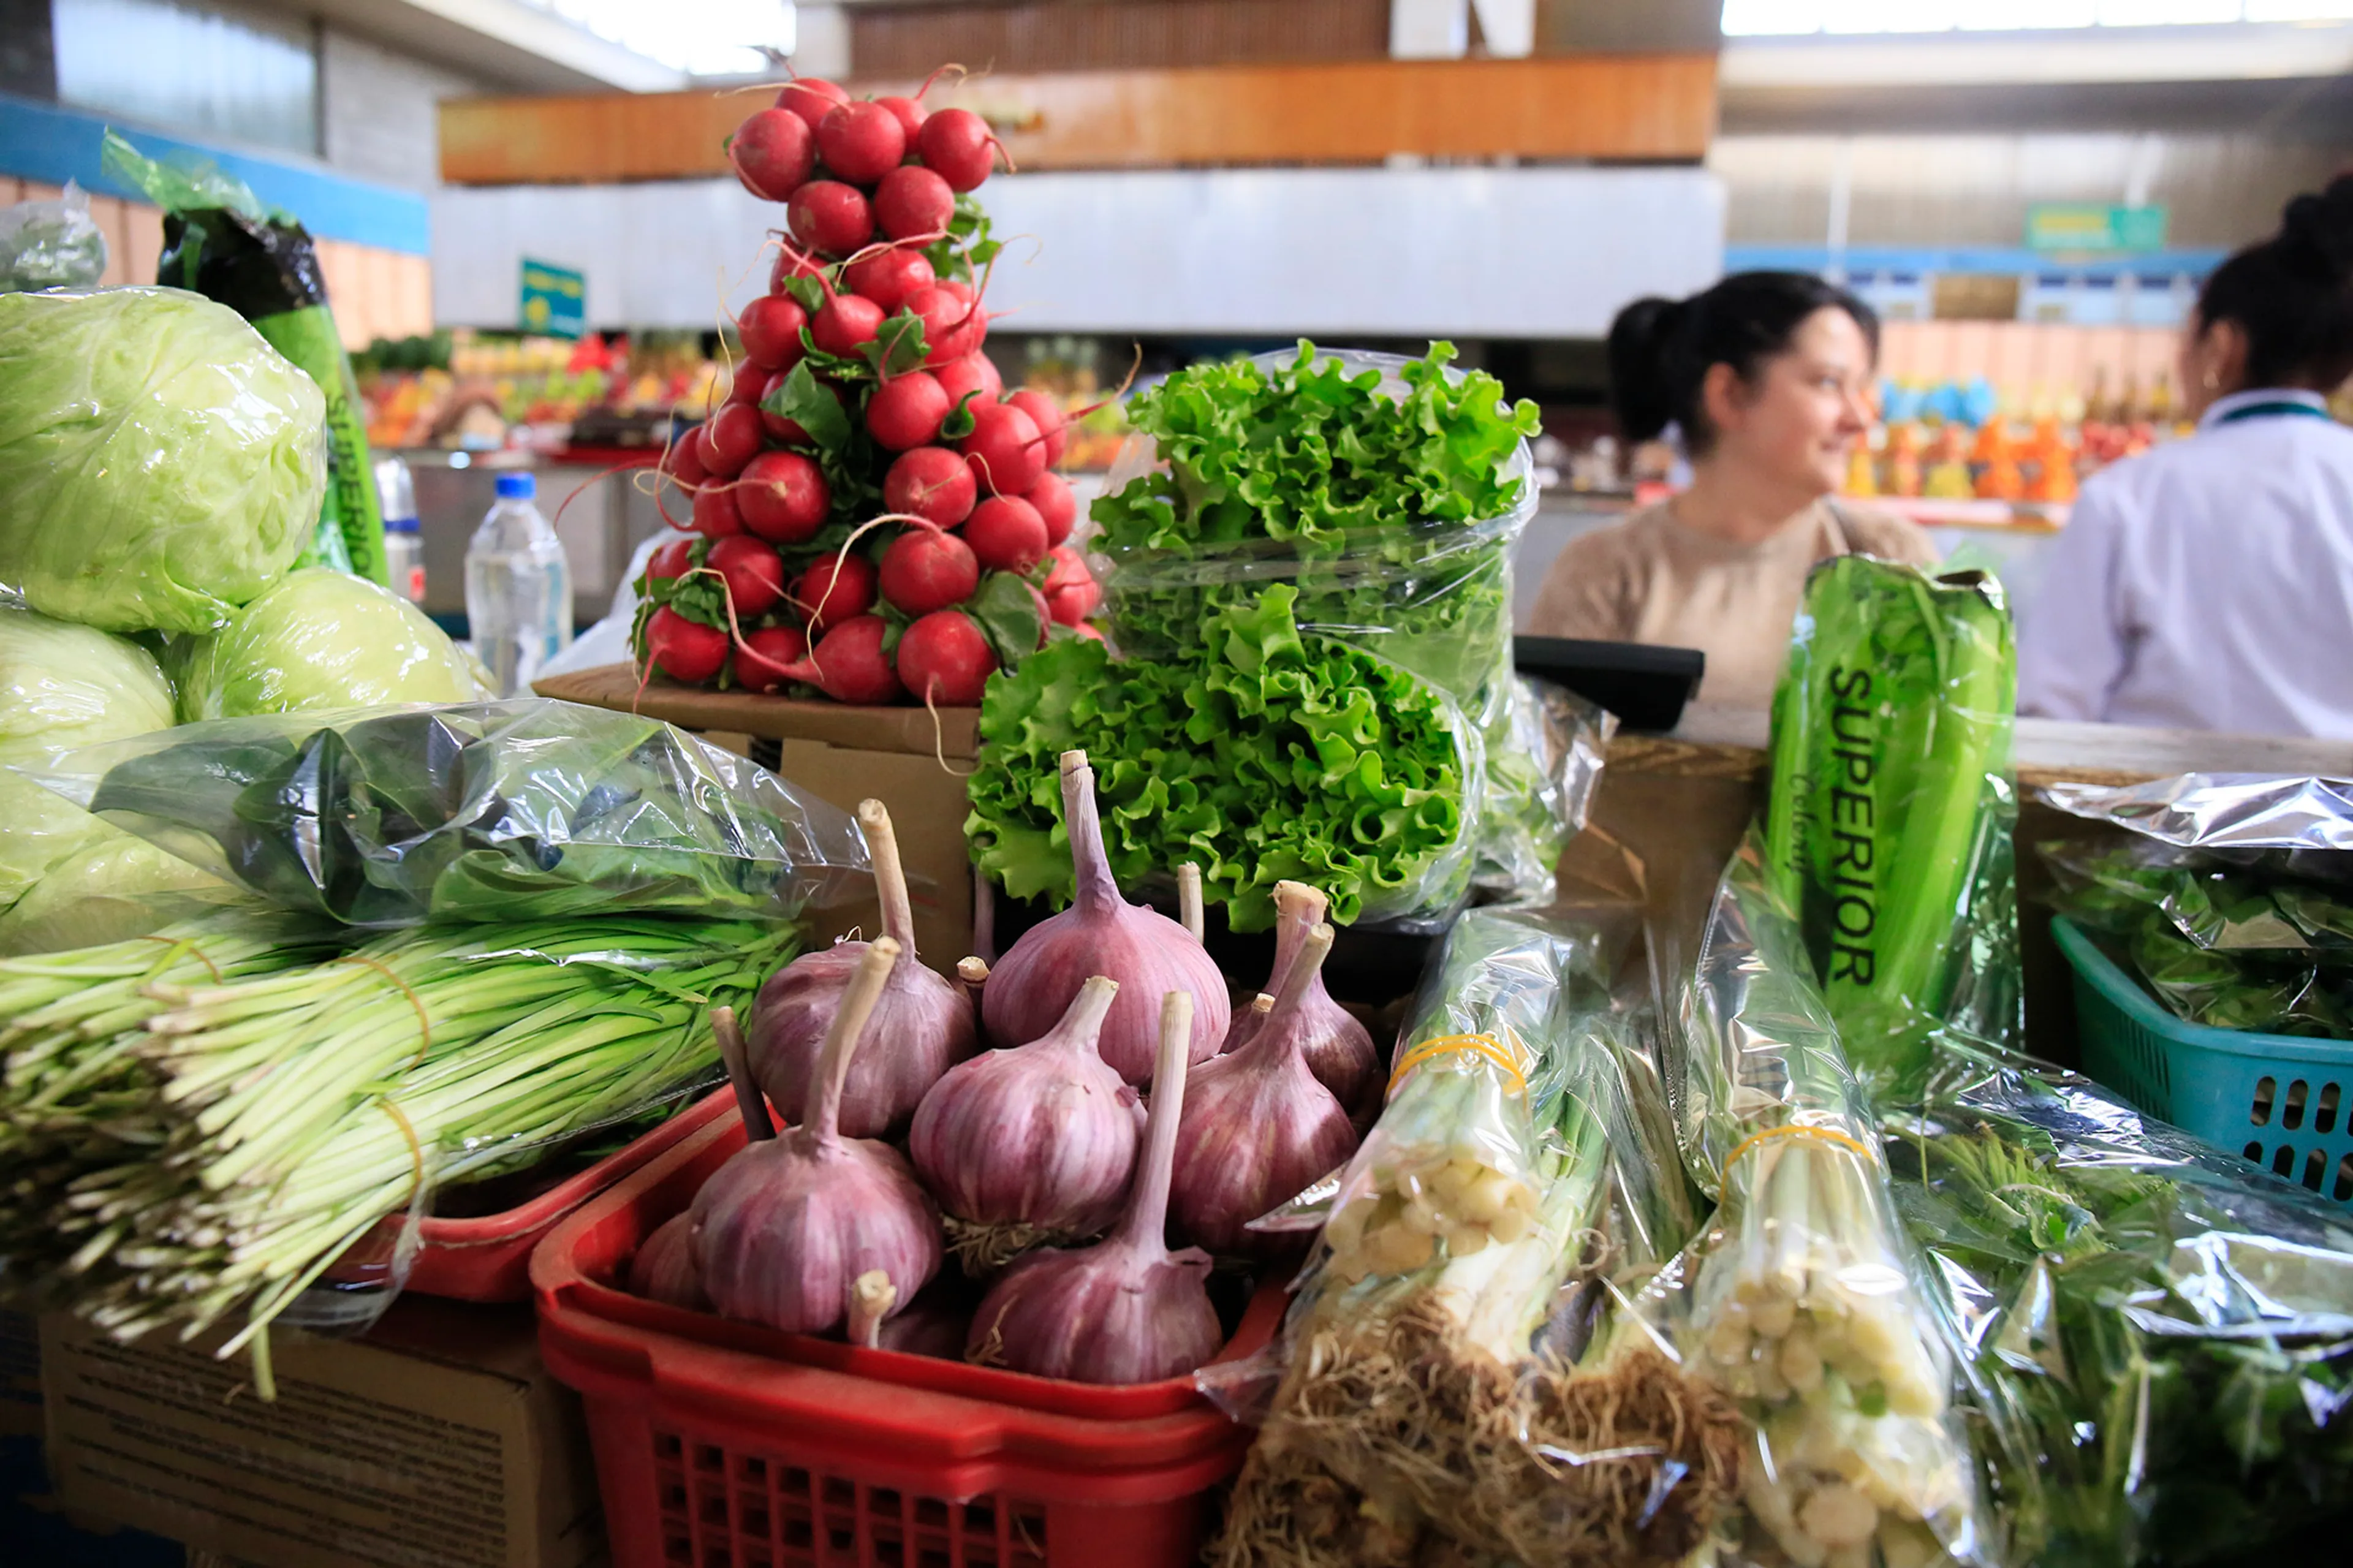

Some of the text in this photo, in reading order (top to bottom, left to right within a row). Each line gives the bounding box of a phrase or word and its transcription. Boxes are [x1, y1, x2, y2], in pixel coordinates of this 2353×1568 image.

[327, 394, 376, 582] SUPERIO
[1784, 773, 1817, 874] Celery
[1829, 666, 1875, 986] SUPERIOR
